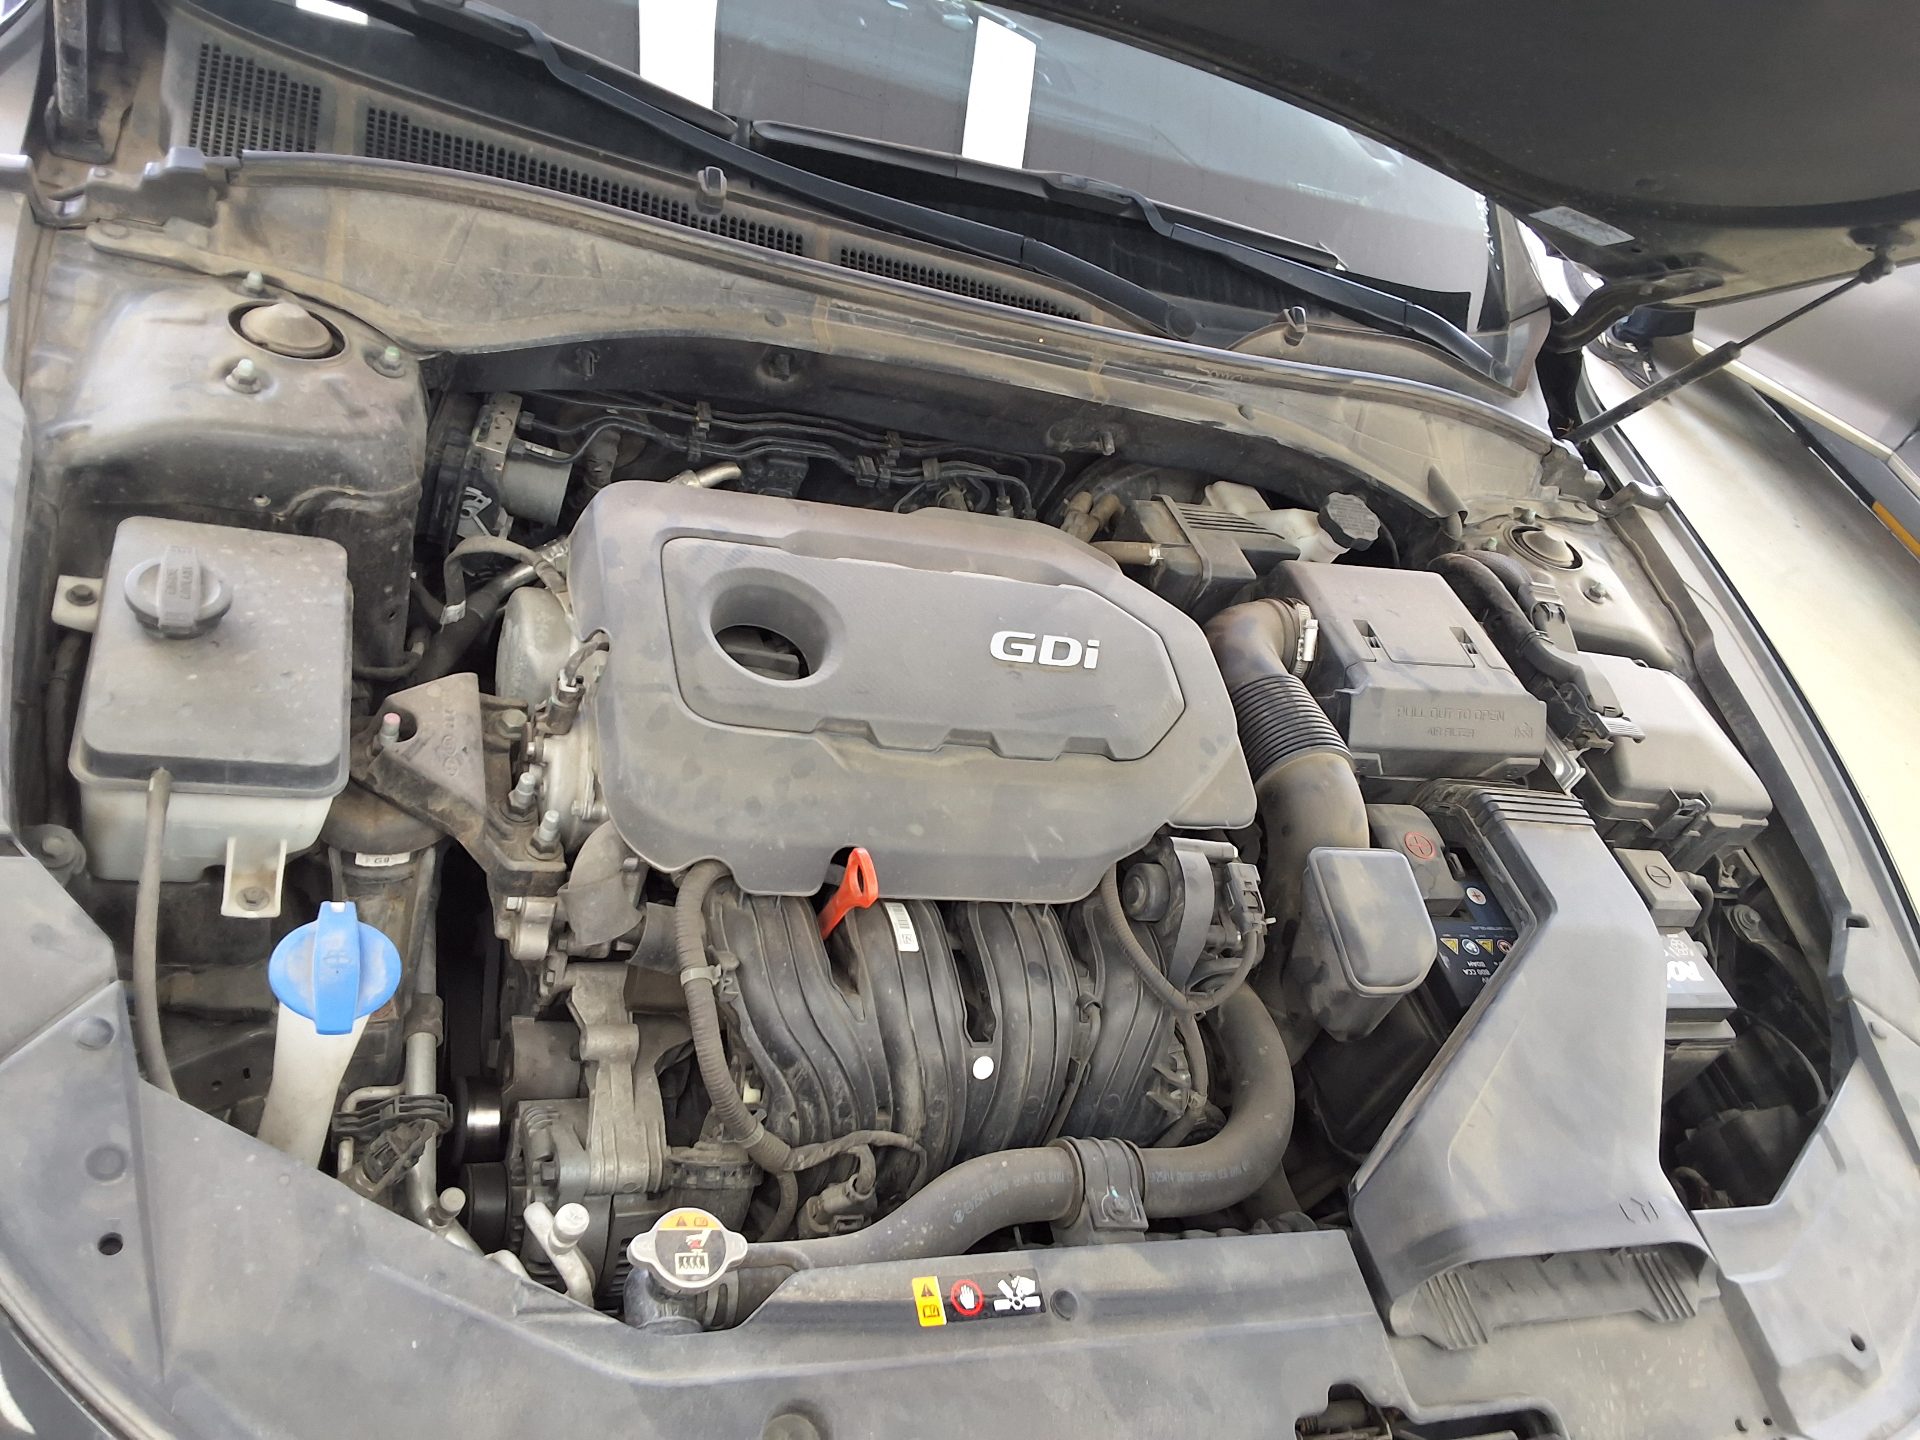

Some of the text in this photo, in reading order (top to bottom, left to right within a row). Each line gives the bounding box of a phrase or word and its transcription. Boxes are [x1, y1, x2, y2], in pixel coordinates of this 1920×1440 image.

[990, 631, 1100, 669] GDi
[1397, 705, 1506, 722] PULL OUT TO OPEN
